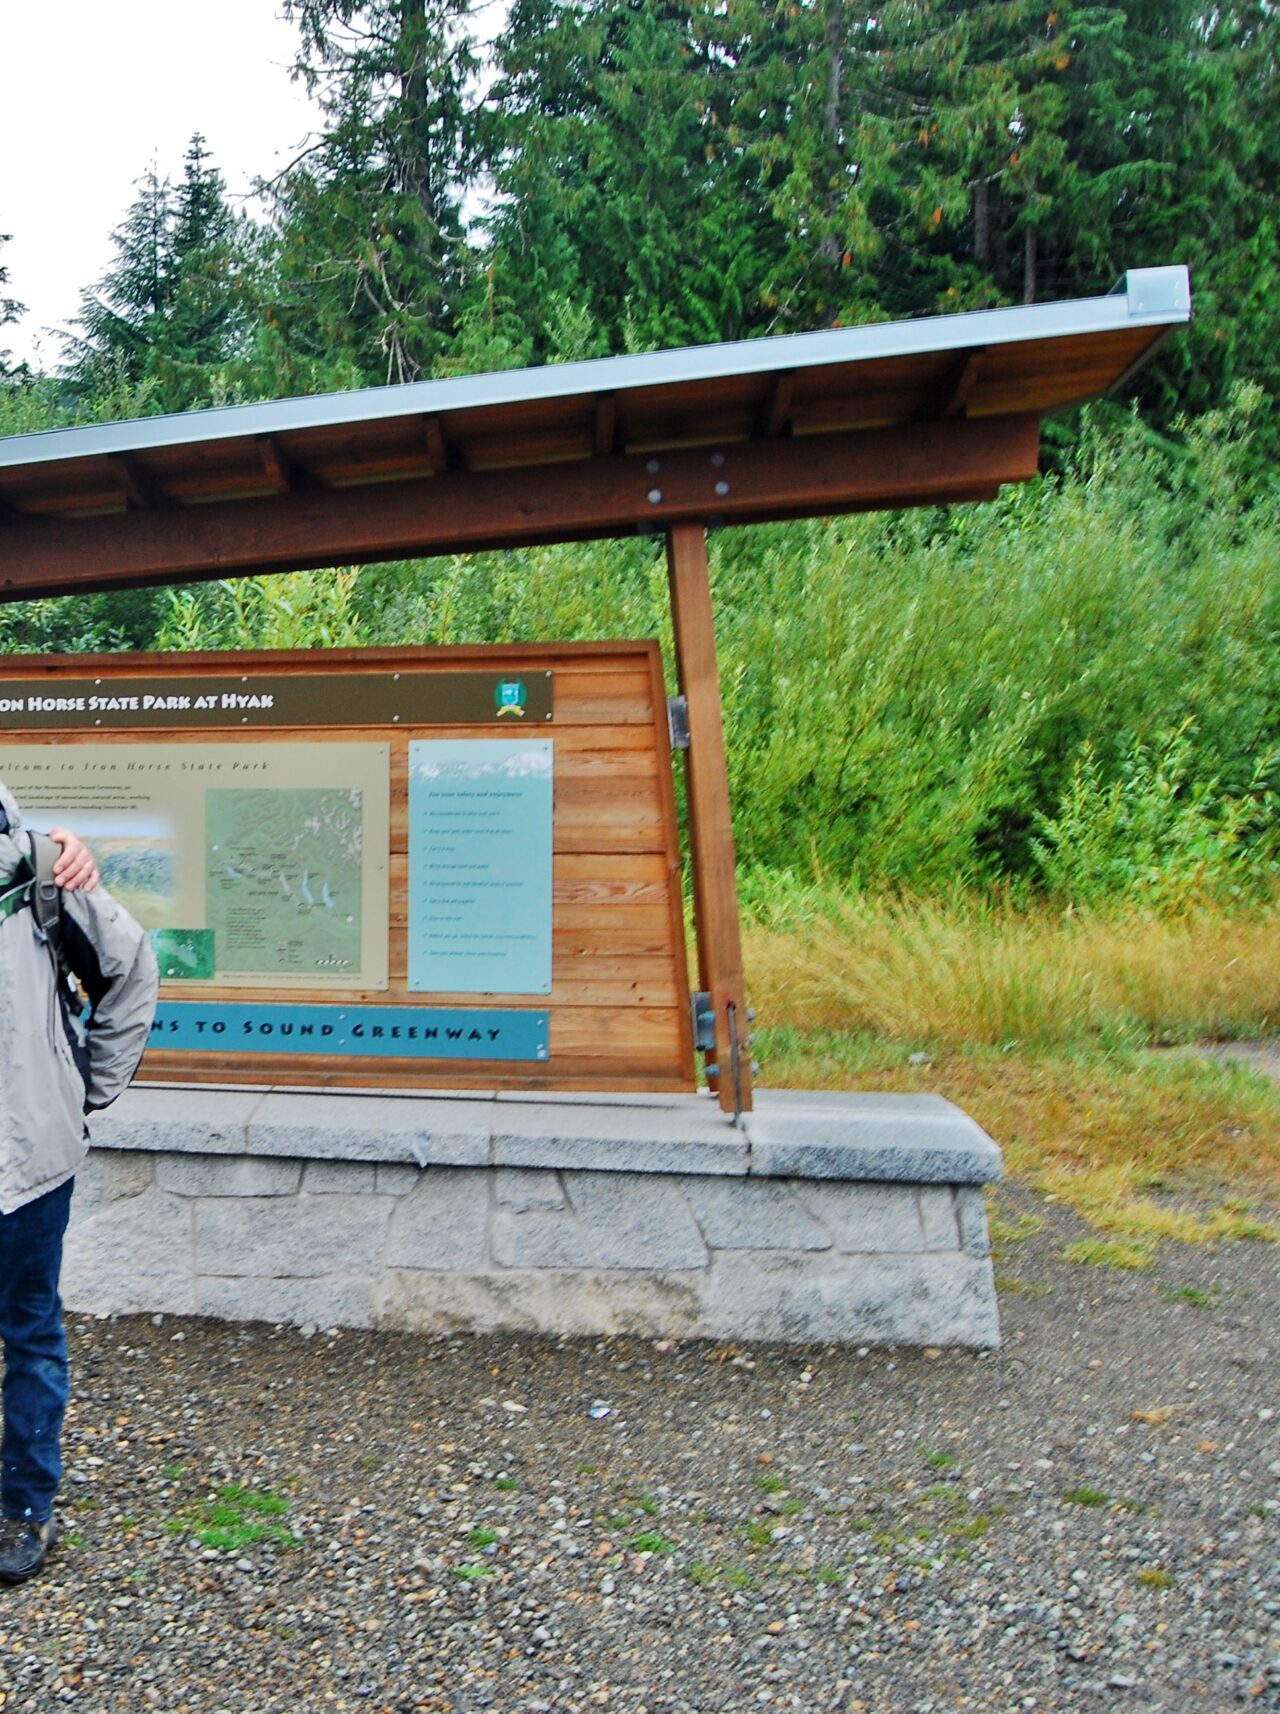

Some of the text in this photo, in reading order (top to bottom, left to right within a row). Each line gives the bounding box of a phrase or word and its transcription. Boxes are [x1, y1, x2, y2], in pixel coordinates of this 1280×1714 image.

[27, 696, 86, 712] HORSE
[88, 695, 139, 711] STATE
[142, 694, 191, 710] PARK
[193, 695, 219, 710] AT
[221, 693, 274, 709] HYAK
[84, 762, 117, 771] Iron
[127, 762, 171, 771] Horse
[181, 762, 222, 771] State
[232, 761, 269, 771] Park
[195, 1020, 227, 1034] TO
[243, 1020, 334, 1037] SOUND
[351, 1023, 501, 1041] GREENWAY
